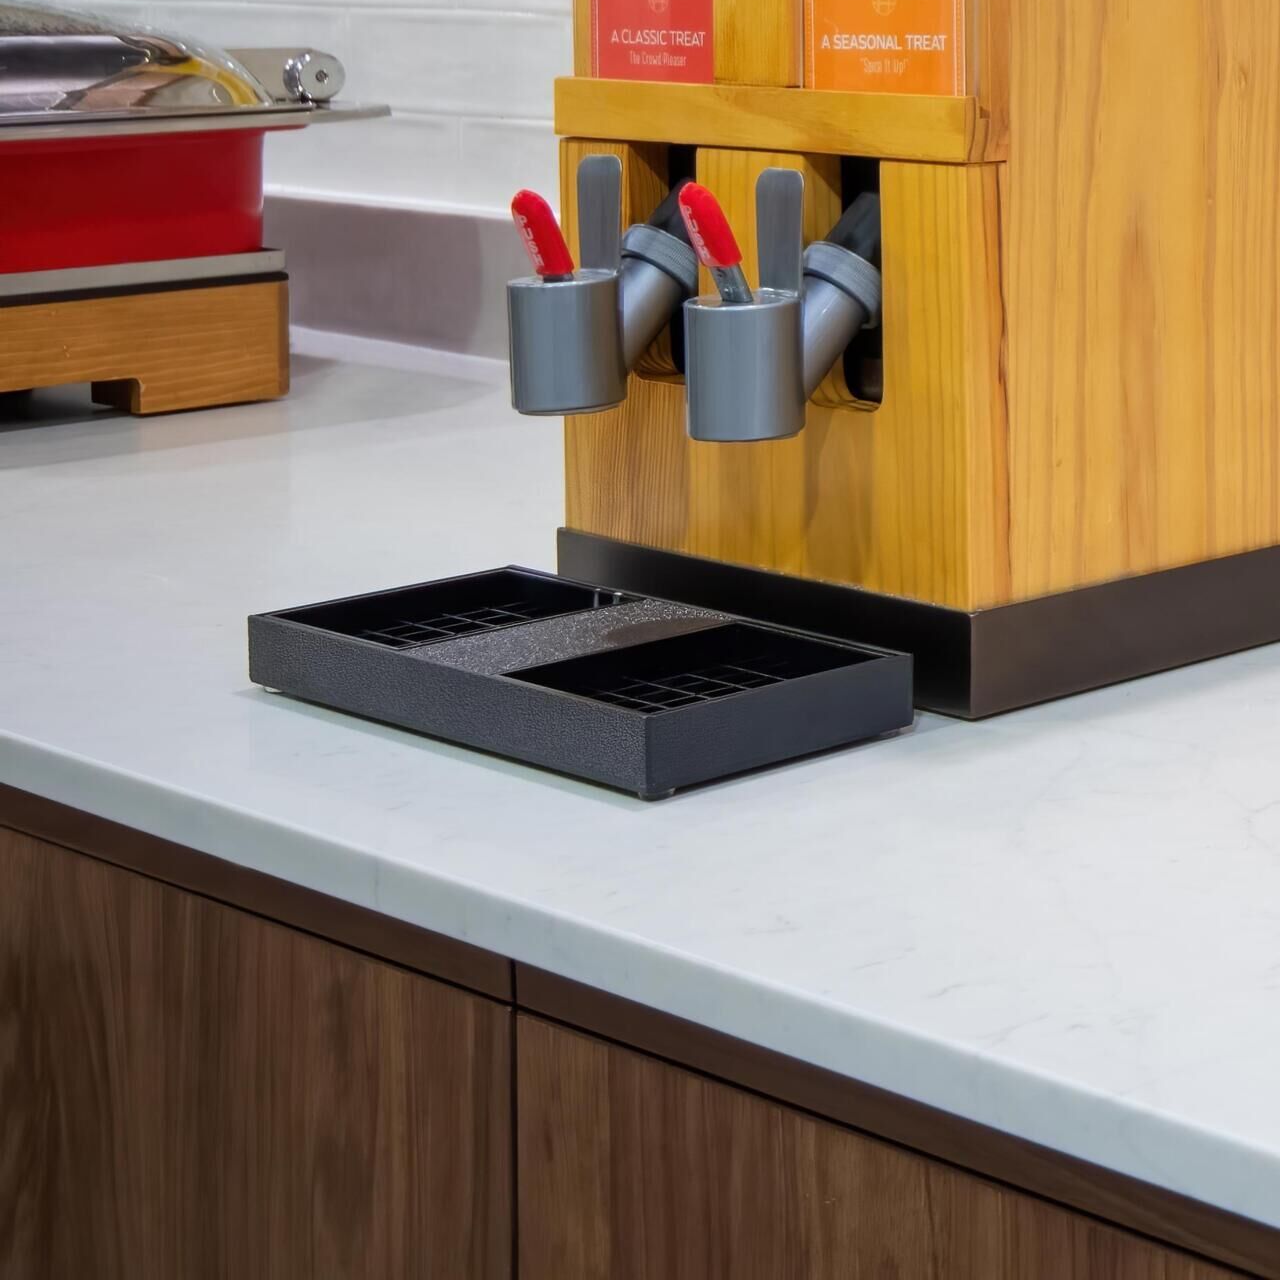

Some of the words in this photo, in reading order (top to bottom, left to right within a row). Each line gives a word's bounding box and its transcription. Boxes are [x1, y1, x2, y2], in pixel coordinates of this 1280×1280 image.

[611, 29, 620, 43] A
[621, 29, 667, 46] CLASSIC
[669, 30, 706, 47] TREAT
[821, 34, 831, 49] A
[833, 34, 902, 50] SEASONAL
[905, 34, 947, 51] TREAT
